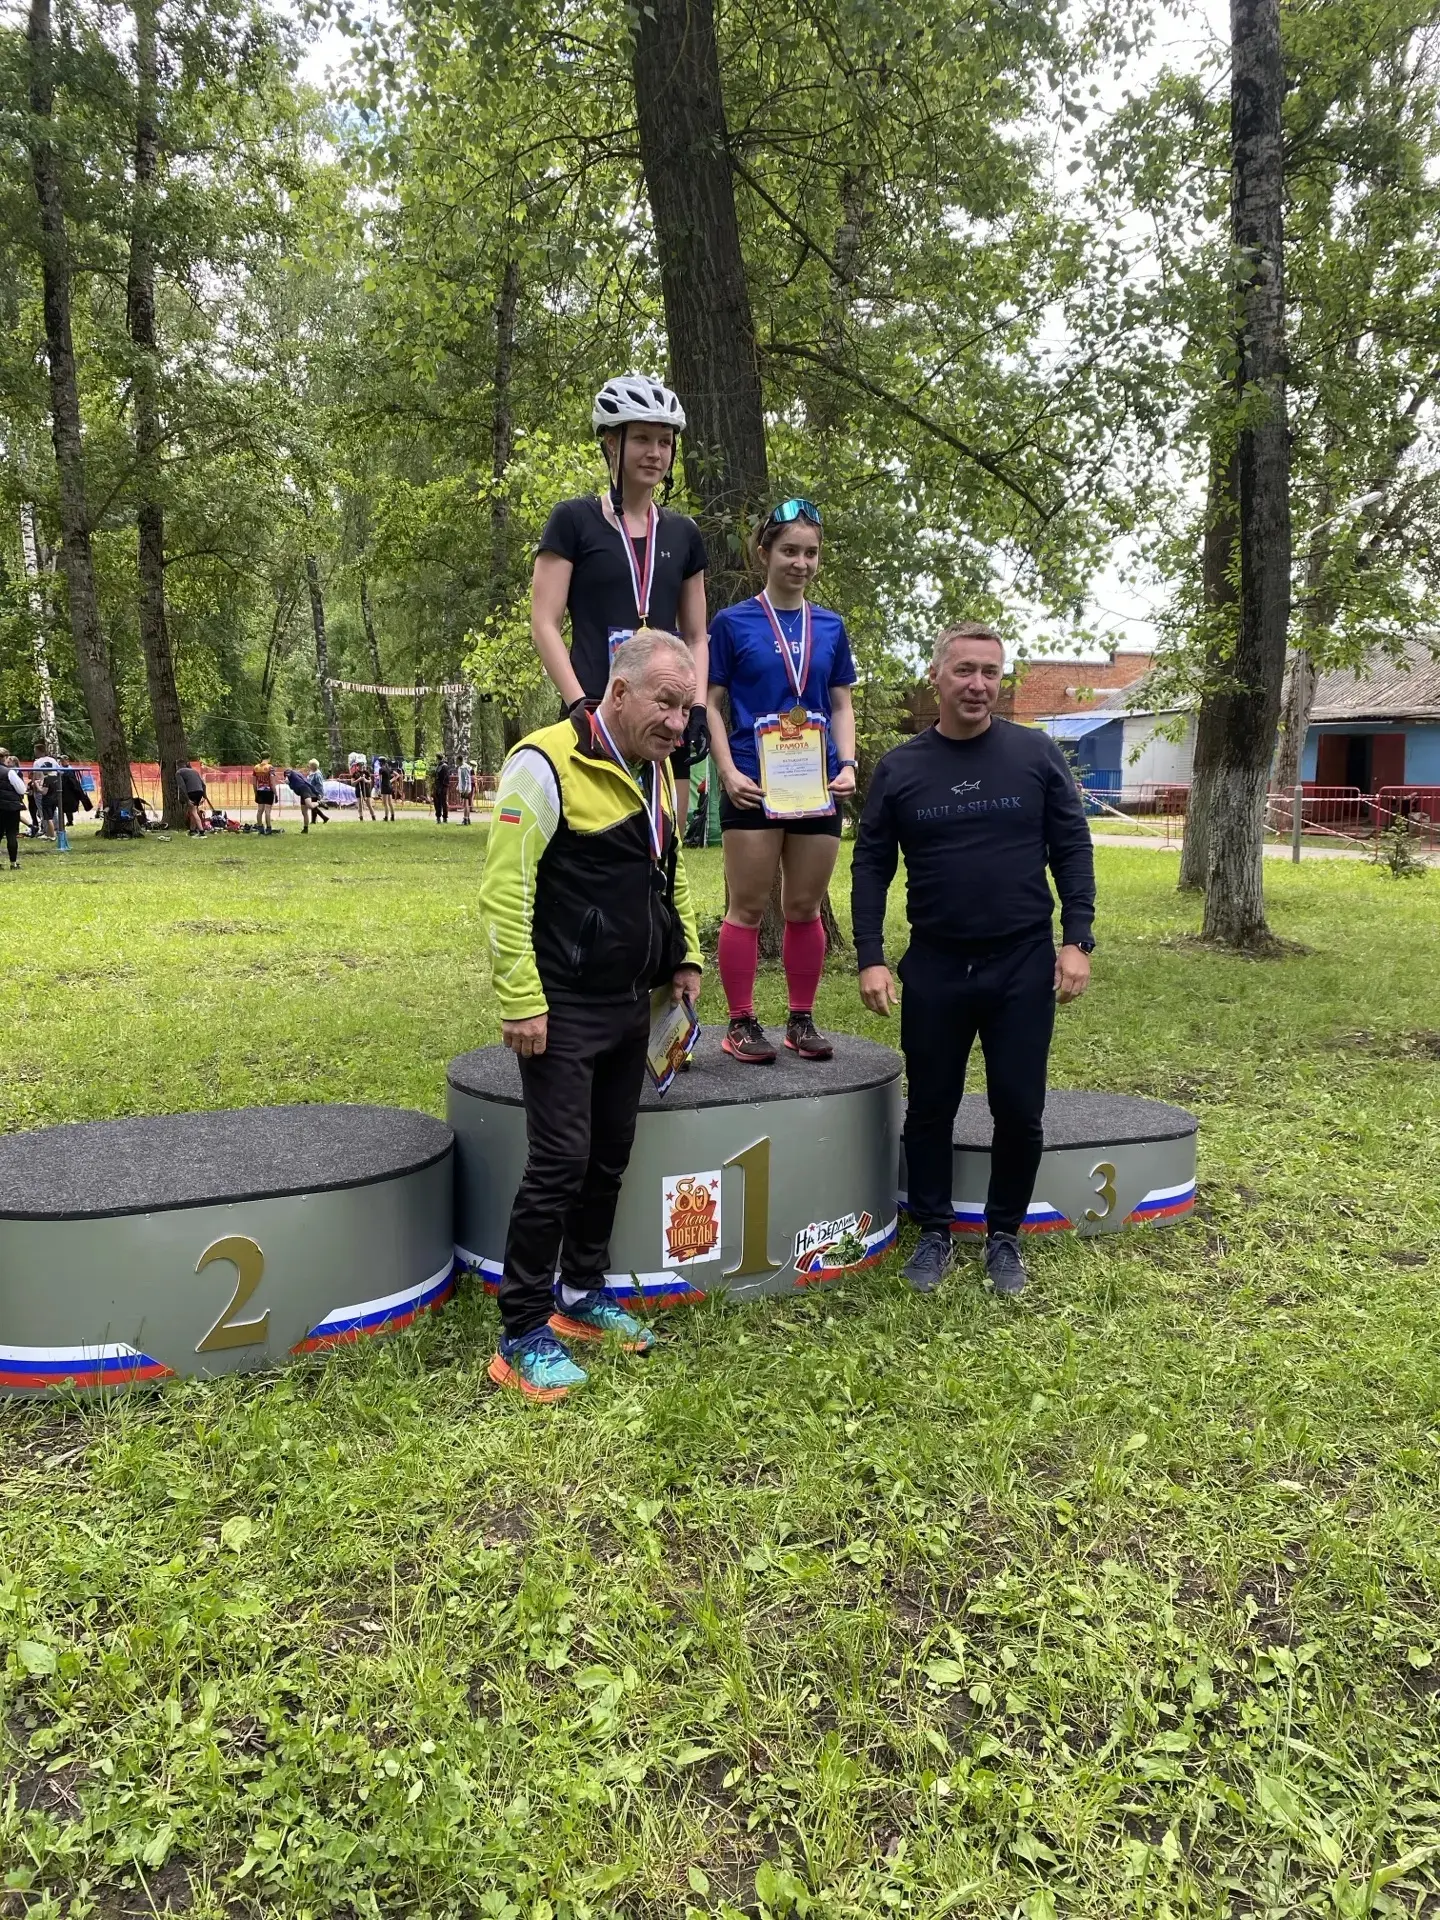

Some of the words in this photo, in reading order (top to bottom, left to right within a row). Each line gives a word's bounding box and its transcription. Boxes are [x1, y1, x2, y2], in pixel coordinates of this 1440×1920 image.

[776, 742, 809, 750] ГРАМОТА
[917, 805, 951, 820] PAUL
[957, 804, 966, 813] &
[968, 796, 1022, 813] SHARK
[675, 1176, 709, 1212] 80
[722, 1135, 783, 1278] 1
[1085, 1161, 1117, 1221] 3
[670, 1224, 713, 1248] ПОБЕДЫ
[194, 1234, 270, 1352] 2
